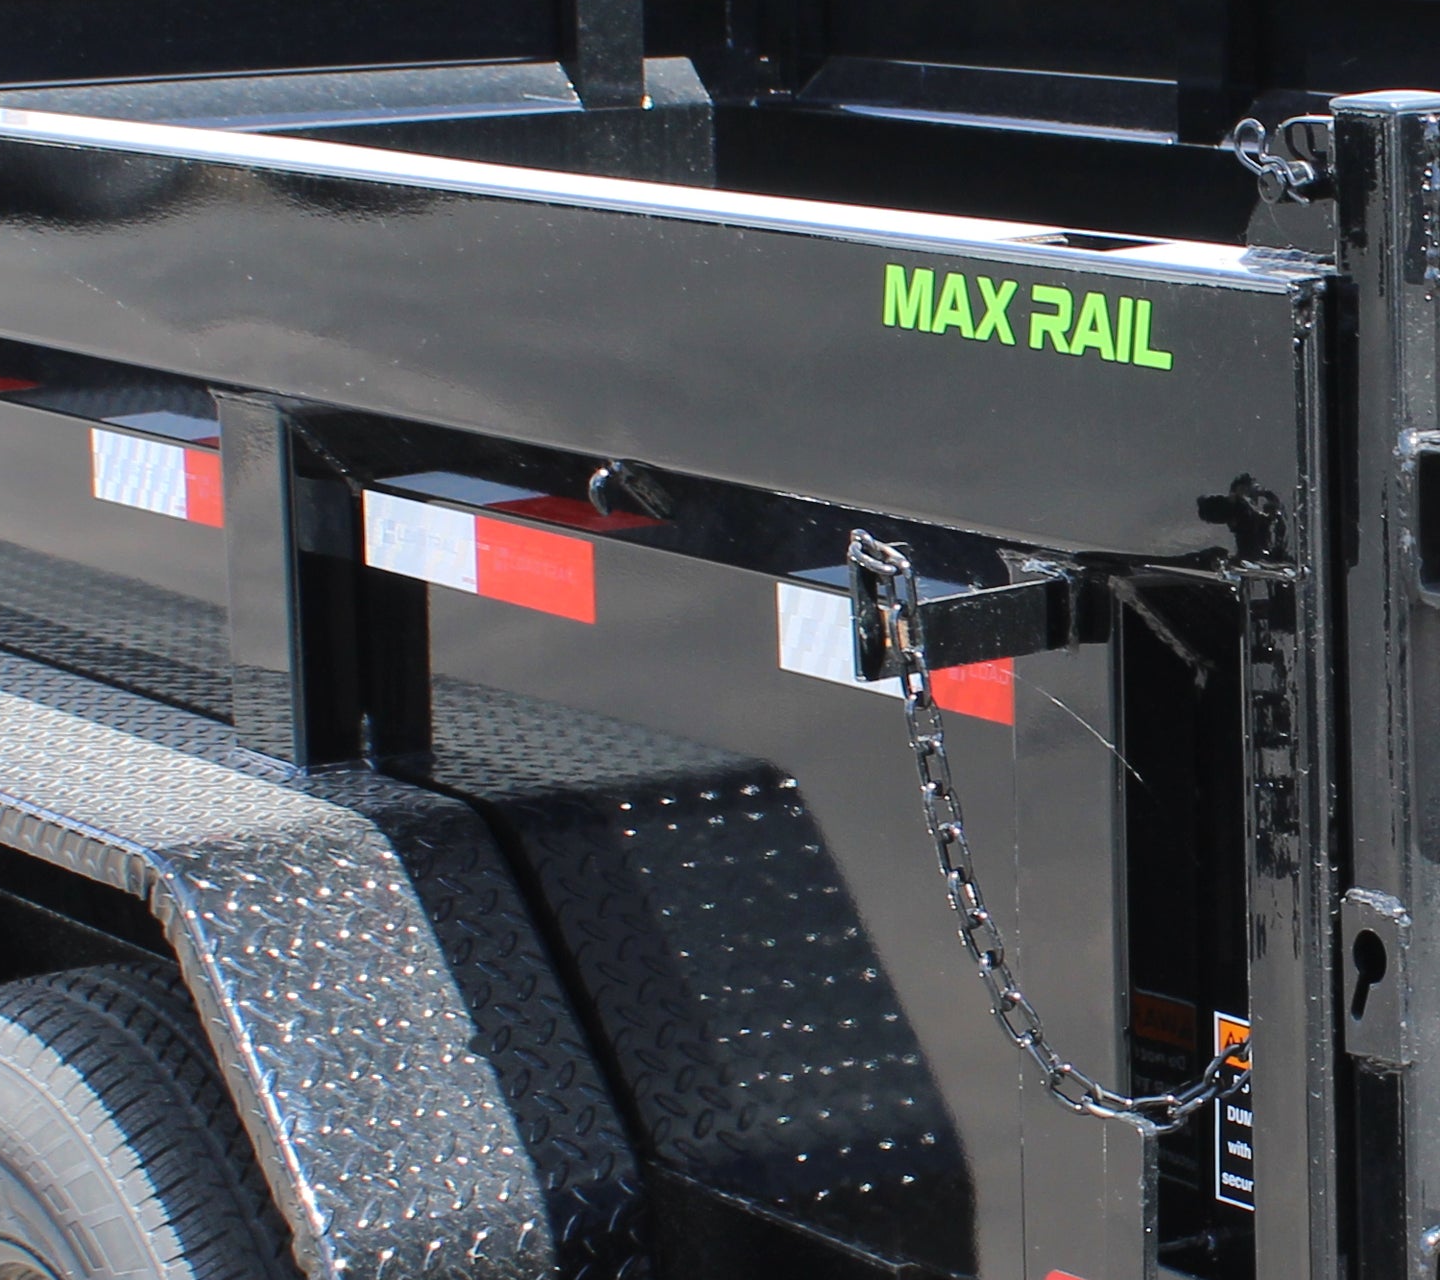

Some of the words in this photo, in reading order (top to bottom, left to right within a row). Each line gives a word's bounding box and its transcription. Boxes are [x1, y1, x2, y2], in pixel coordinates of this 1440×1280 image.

[882, 263, 1019, 346] MAX
[1029, 283, 1174, 371] RAIL
[1227, 1140, 1252, 1160] with
